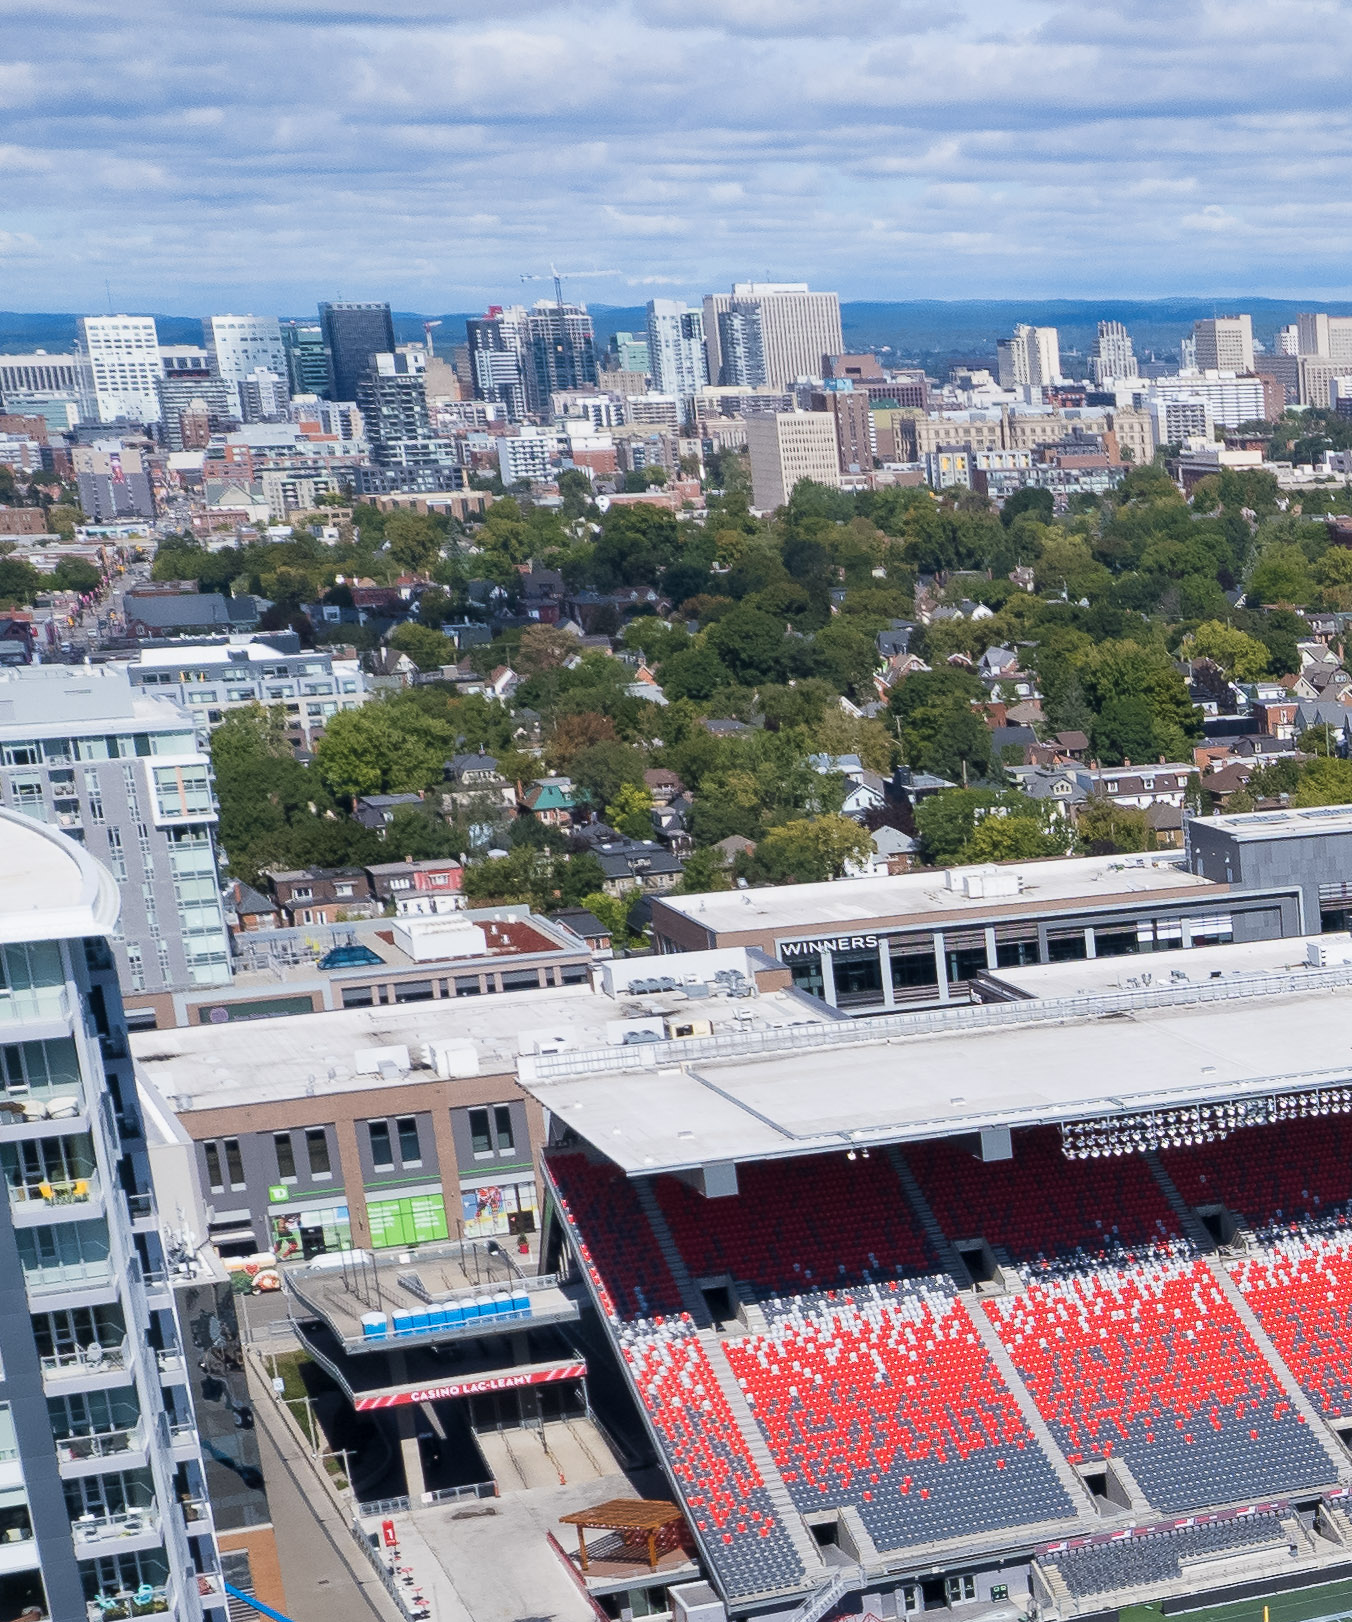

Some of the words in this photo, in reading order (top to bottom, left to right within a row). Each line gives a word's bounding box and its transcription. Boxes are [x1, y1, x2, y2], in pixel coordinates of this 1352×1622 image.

[781, 936, 878, 956] WINNERS
[272, 1188, 287, 1198] TD
[410, 1386, 460, 1402] CASINO
[463, 1374, 532, 1394] LAC-LEAMY
[386, 1528, 394, 1540] 1
